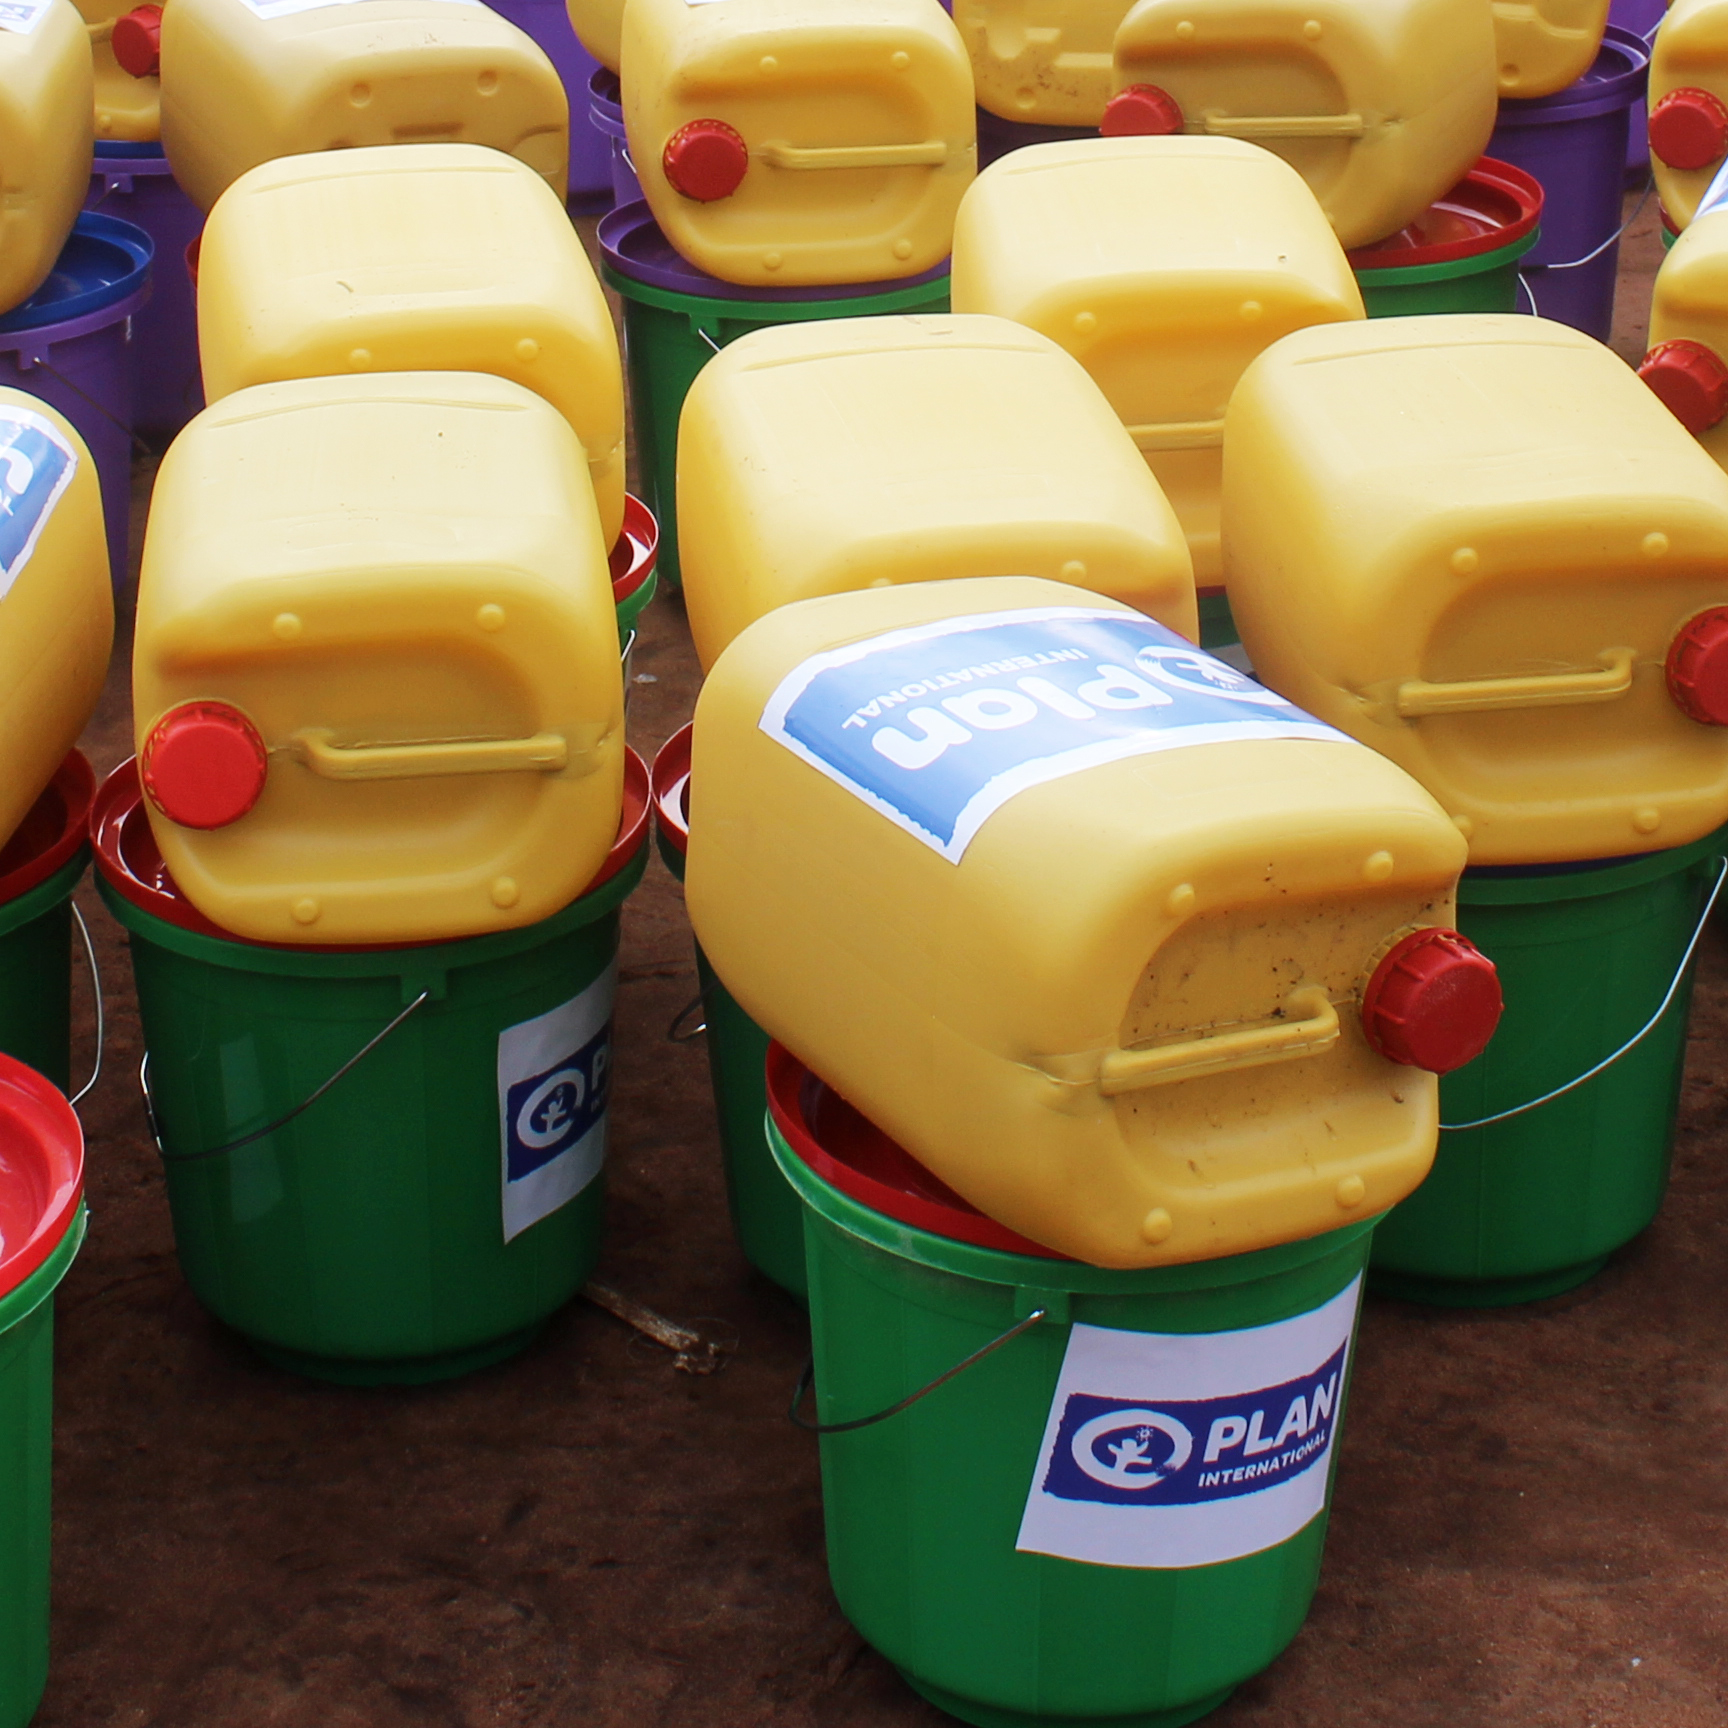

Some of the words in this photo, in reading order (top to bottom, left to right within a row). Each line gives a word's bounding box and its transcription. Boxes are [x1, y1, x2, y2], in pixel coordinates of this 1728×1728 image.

[841, 647, 1090, 731] INTERNATIONAL
[870, 663, 1174, 771] Plan
[1197, 1428, 1326, 1487] INTERNATIONAL
[1203, 1371, 1337, 1464] PLAN
